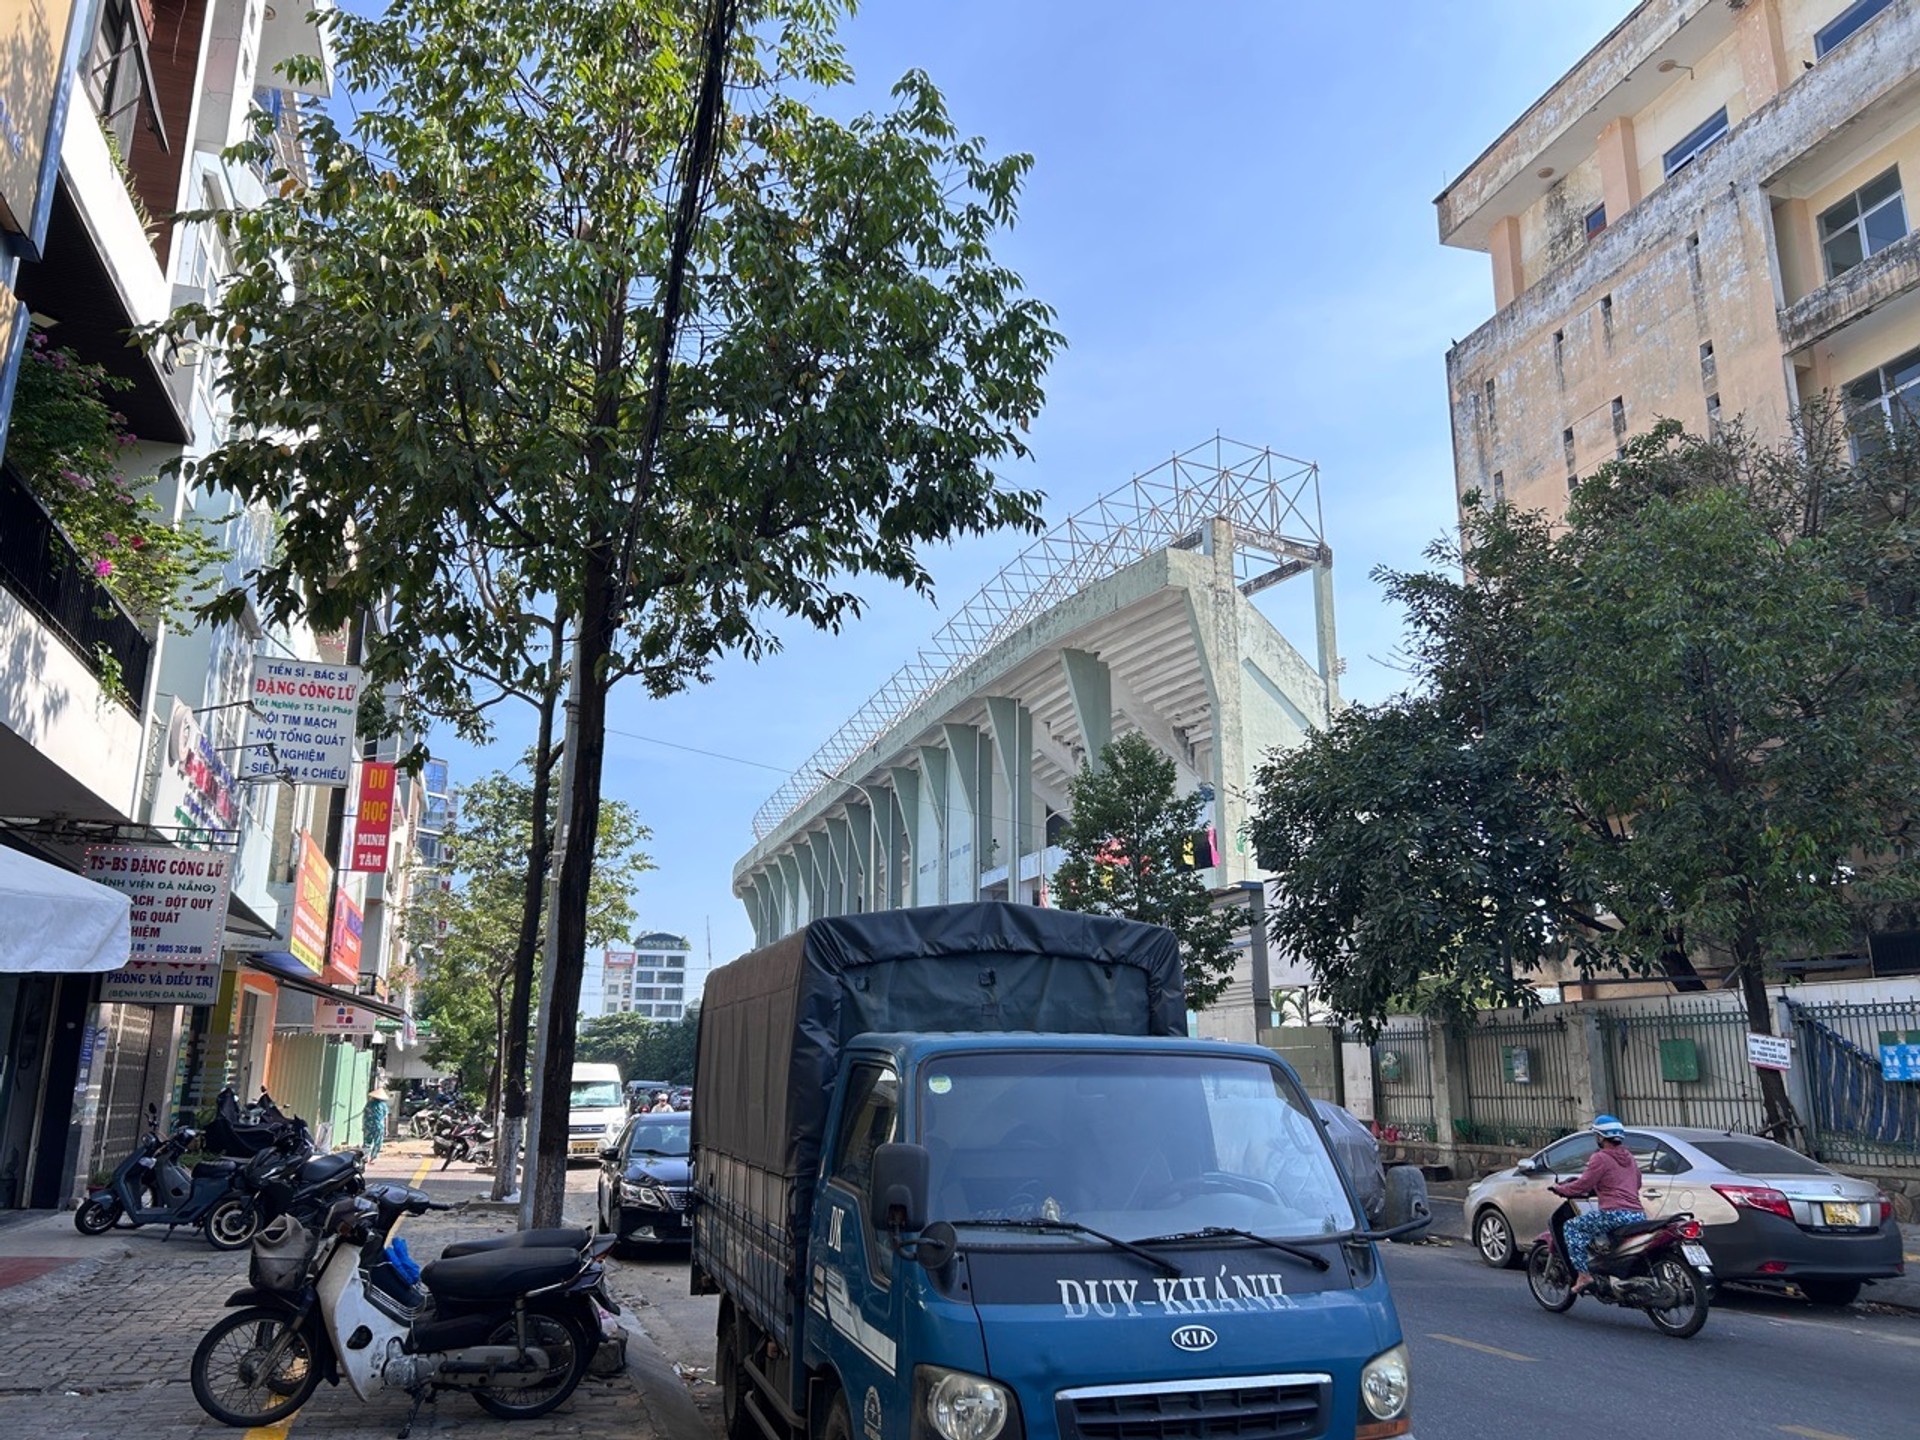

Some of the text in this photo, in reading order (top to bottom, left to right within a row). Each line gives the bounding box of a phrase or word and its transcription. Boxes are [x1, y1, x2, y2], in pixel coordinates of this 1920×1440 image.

[268, 662, 292, 677] TIẾN
[314, 669, 334, 680] BÁC
[256, 677, 296, 697] ĐẶNG
[299, 681, 335, 699] CÔNG
[304, 703, 314, 711] TS
[282, 714, 300, 725] TIM
[304, 717, 337, 729] MẠCH
[256, 728, 277, 741] NỘI
[280, 727, 312, 744] TỔNG
[315, 733, 346, 747] QUÁT
[280, 748, 325, 763] NGHIỆM
[301, 767, 308, 777] 4
[369, 768, 388, 789] DU
[361, 801, 388, 825] HỌC
[358, 833, 387, 846] MINH
[91, 855, 128, 871] TS-BS
[131, 855, 166, 876] ĐẶNG
[170, 857, 205, 877] CÔNG
[359, 852, 382, 867] TÂM
[165, 895, 188, 910] ĐỘT
[150, 910, 181, 923] QUÁT
[107, 971, 146, 984] PHÒNG
[149, 972, 163, 985] VÀ
[195, 975, 214, 989] TRỊ
[1057, 1264, 1299, 1319] DUY-KHÁNH
[1179, 1330, 1211, 1346] KIA
